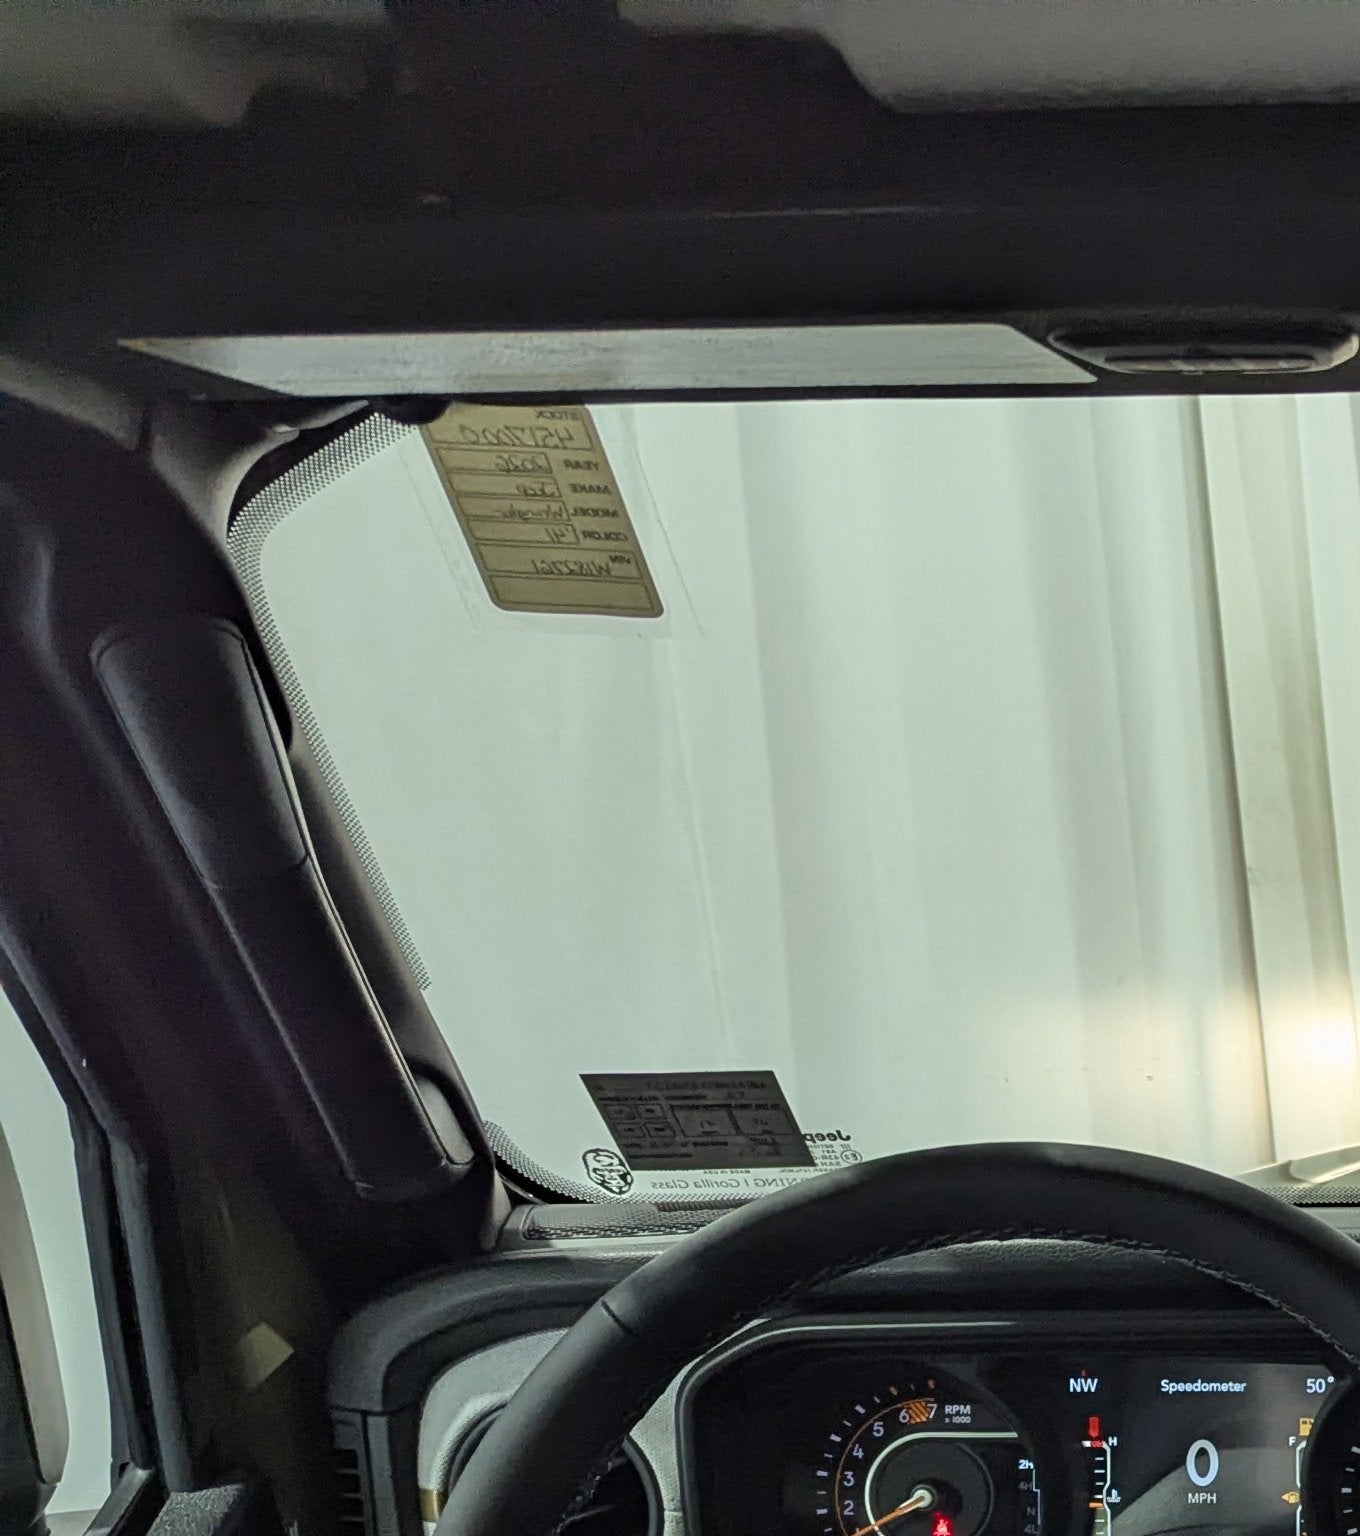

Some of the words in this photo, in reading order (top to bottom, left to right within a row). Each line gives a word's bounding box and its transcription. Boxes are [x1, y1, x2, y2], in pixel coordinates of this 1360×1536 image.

[1069, 1378, 1098, 1393] NW
[1160, 1379, 1247, 1394] Speedometer
[1306, 1376, 1334, 1394] 50°
[899, 1408, 910, 1423] 6
[927, 1403, 938, 1419] 7
[944, 1404, 971, 1415] RPM
[873, 1421, 885, 1438] 5
[1108, 1437, 1118, 1447] H
[1288, 1437, 1296, 1447] F
[852, 1444, 864, 1459] 4
[1186, 1439, 1219, 1486] 0
[843, 1472, 855, 1486] 3
[1187, 1492, 1217, 1504] MPH
[843, 1501, 855, 1516] 2
